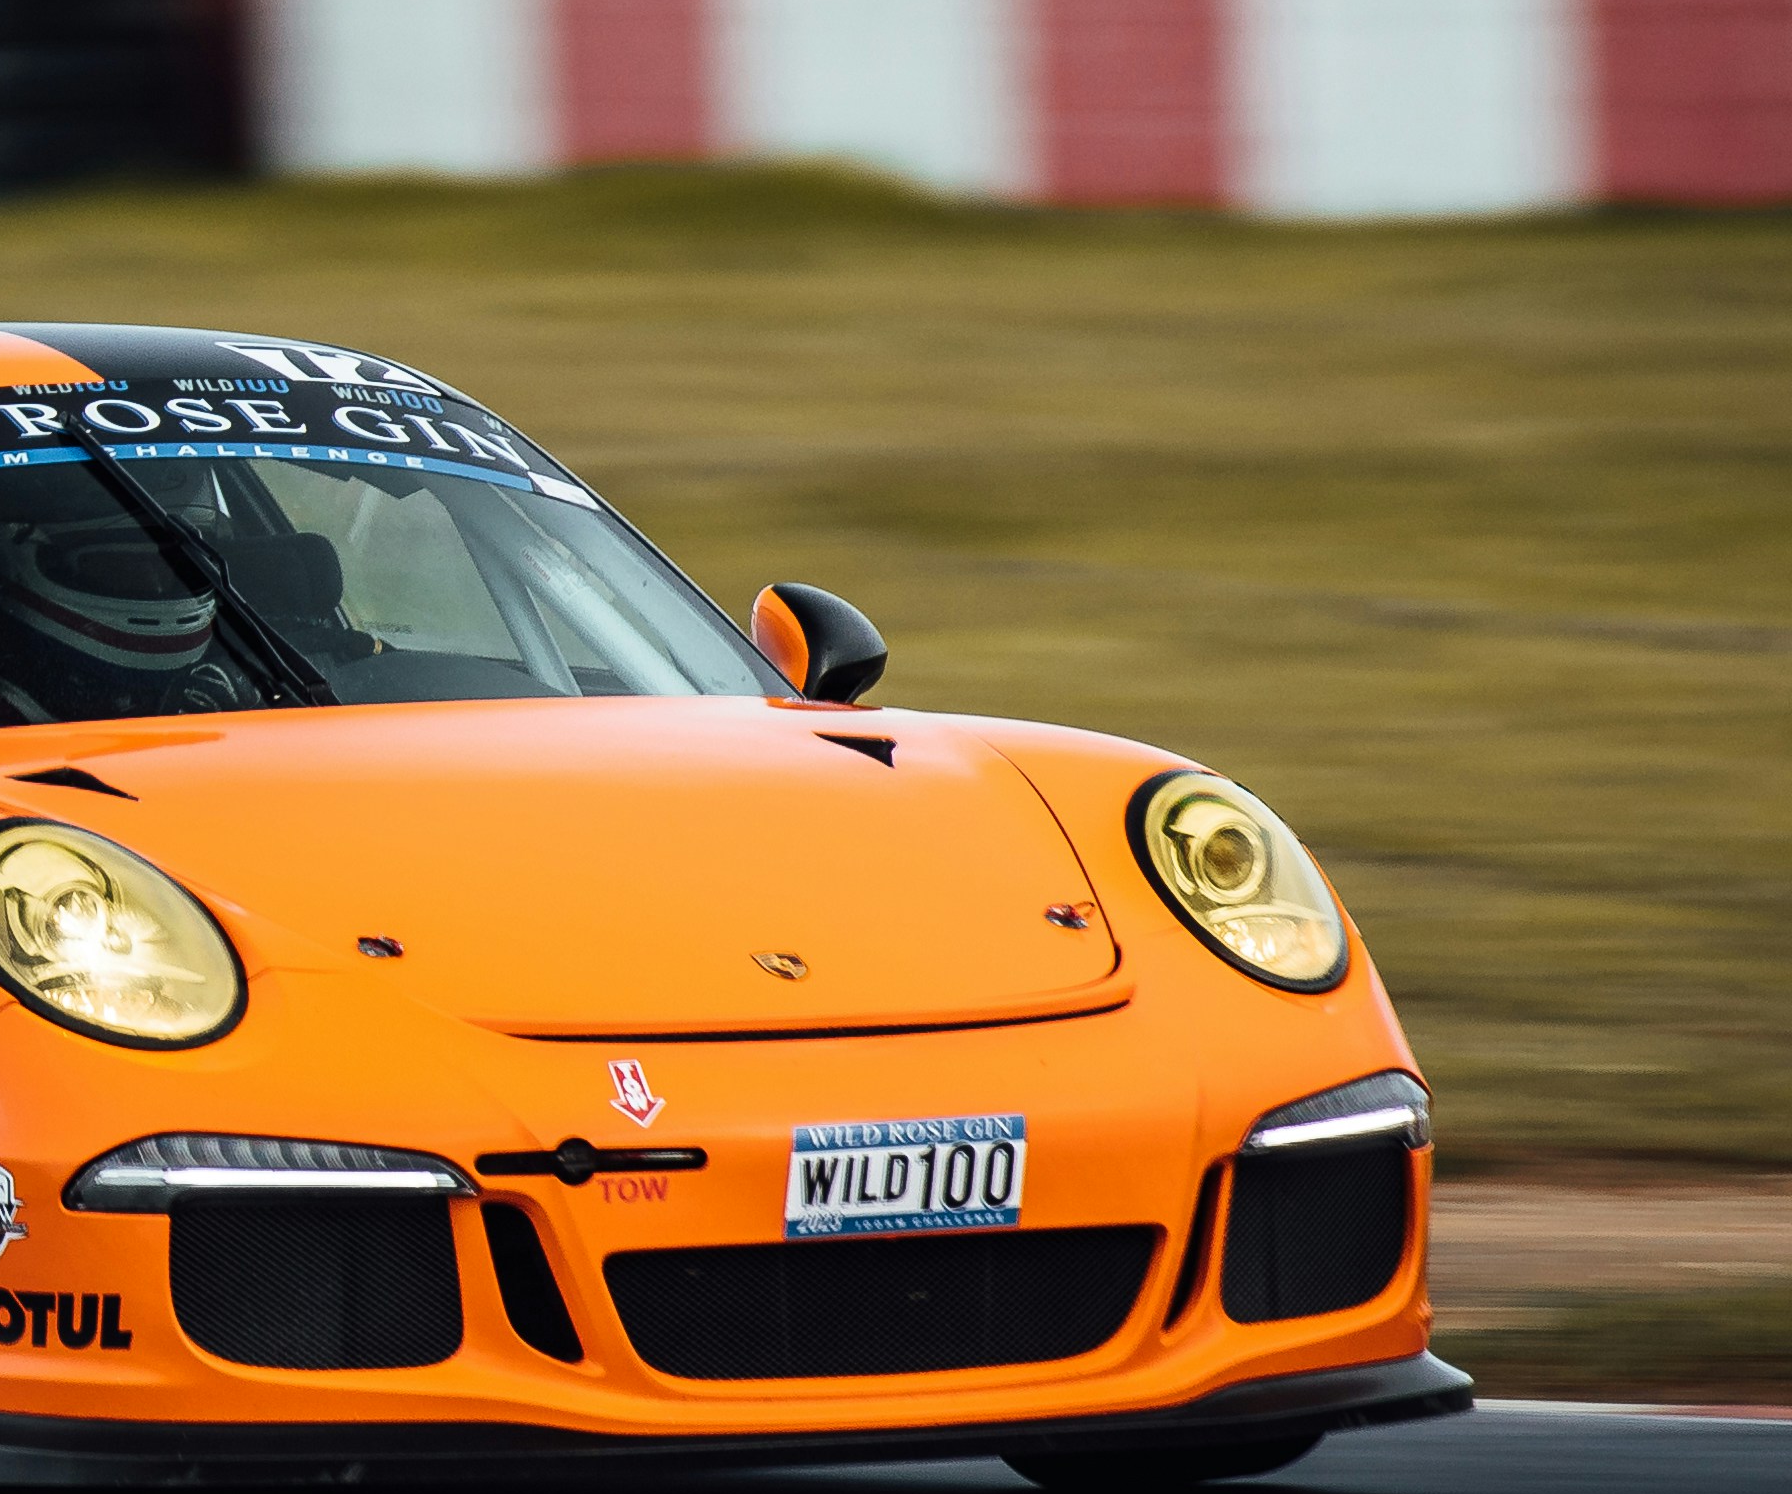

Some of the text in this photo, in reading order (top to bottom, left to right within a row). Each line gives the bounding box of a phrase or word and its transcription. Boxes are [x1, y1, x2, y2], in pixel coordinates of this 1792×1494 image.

[332, 407, 531, 471] GIN
[616, 1062, 649, 1112] TOW
[808, 1116, 1013, 1148] WILD ROSE GIN
[596, 1176, 669, 1204] TOW
[800, 1140, 1016, 1212] WILD100
